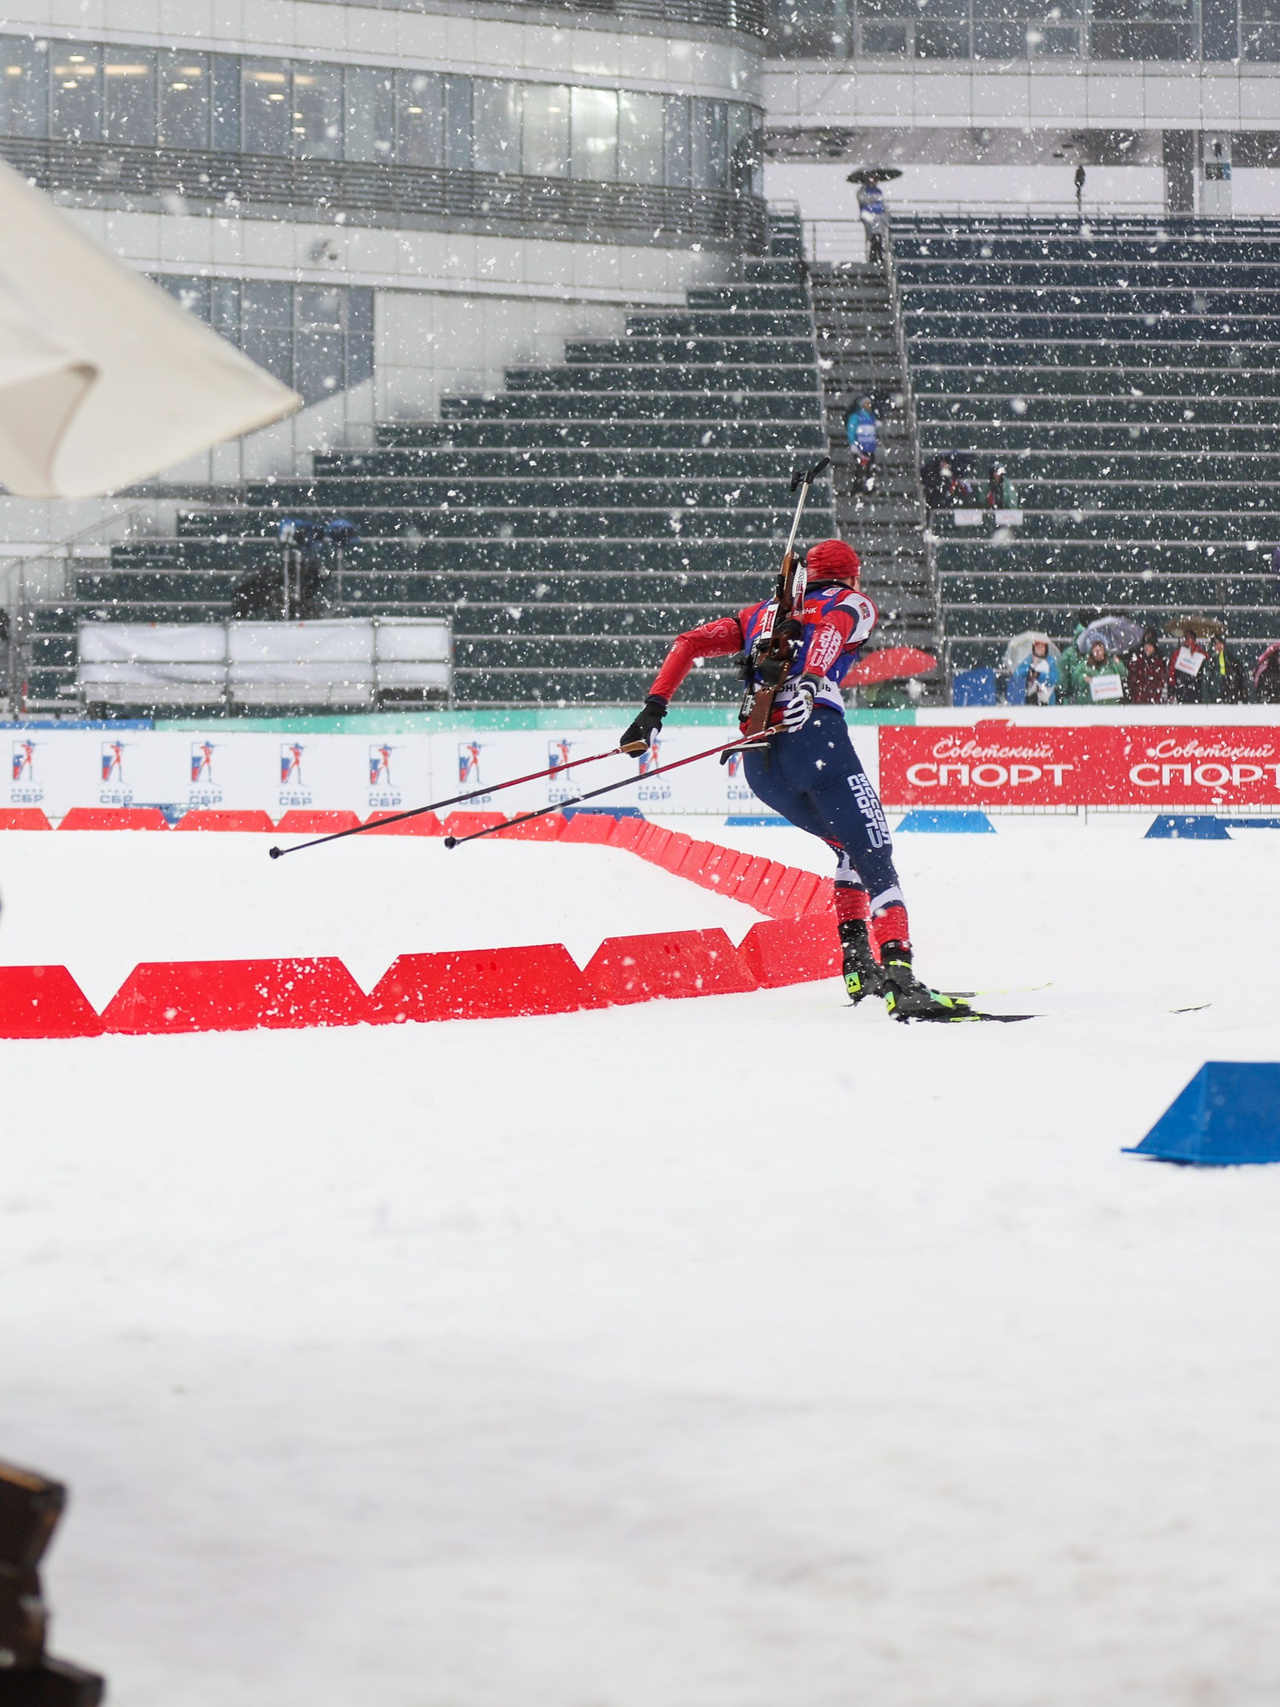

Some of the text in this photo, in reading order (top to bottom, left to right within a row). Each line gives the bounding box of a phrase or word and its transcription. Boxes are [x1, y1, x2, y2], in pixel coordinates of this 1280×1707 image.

[931, 739, 1052, 759] Советский
[1154, 738, 1275, 758] Советский
[906, 763, 1074, 787] СПОРТ
[100, 794, 134, 804] СБР
[189, 795, 223, 804] СБР
[638, 791, 671, 800] СБР
[279, 796, 312, 806] СБР
[368, 798, 402, 807] СБР
[847, 774, 880, 830] СПОРТ
